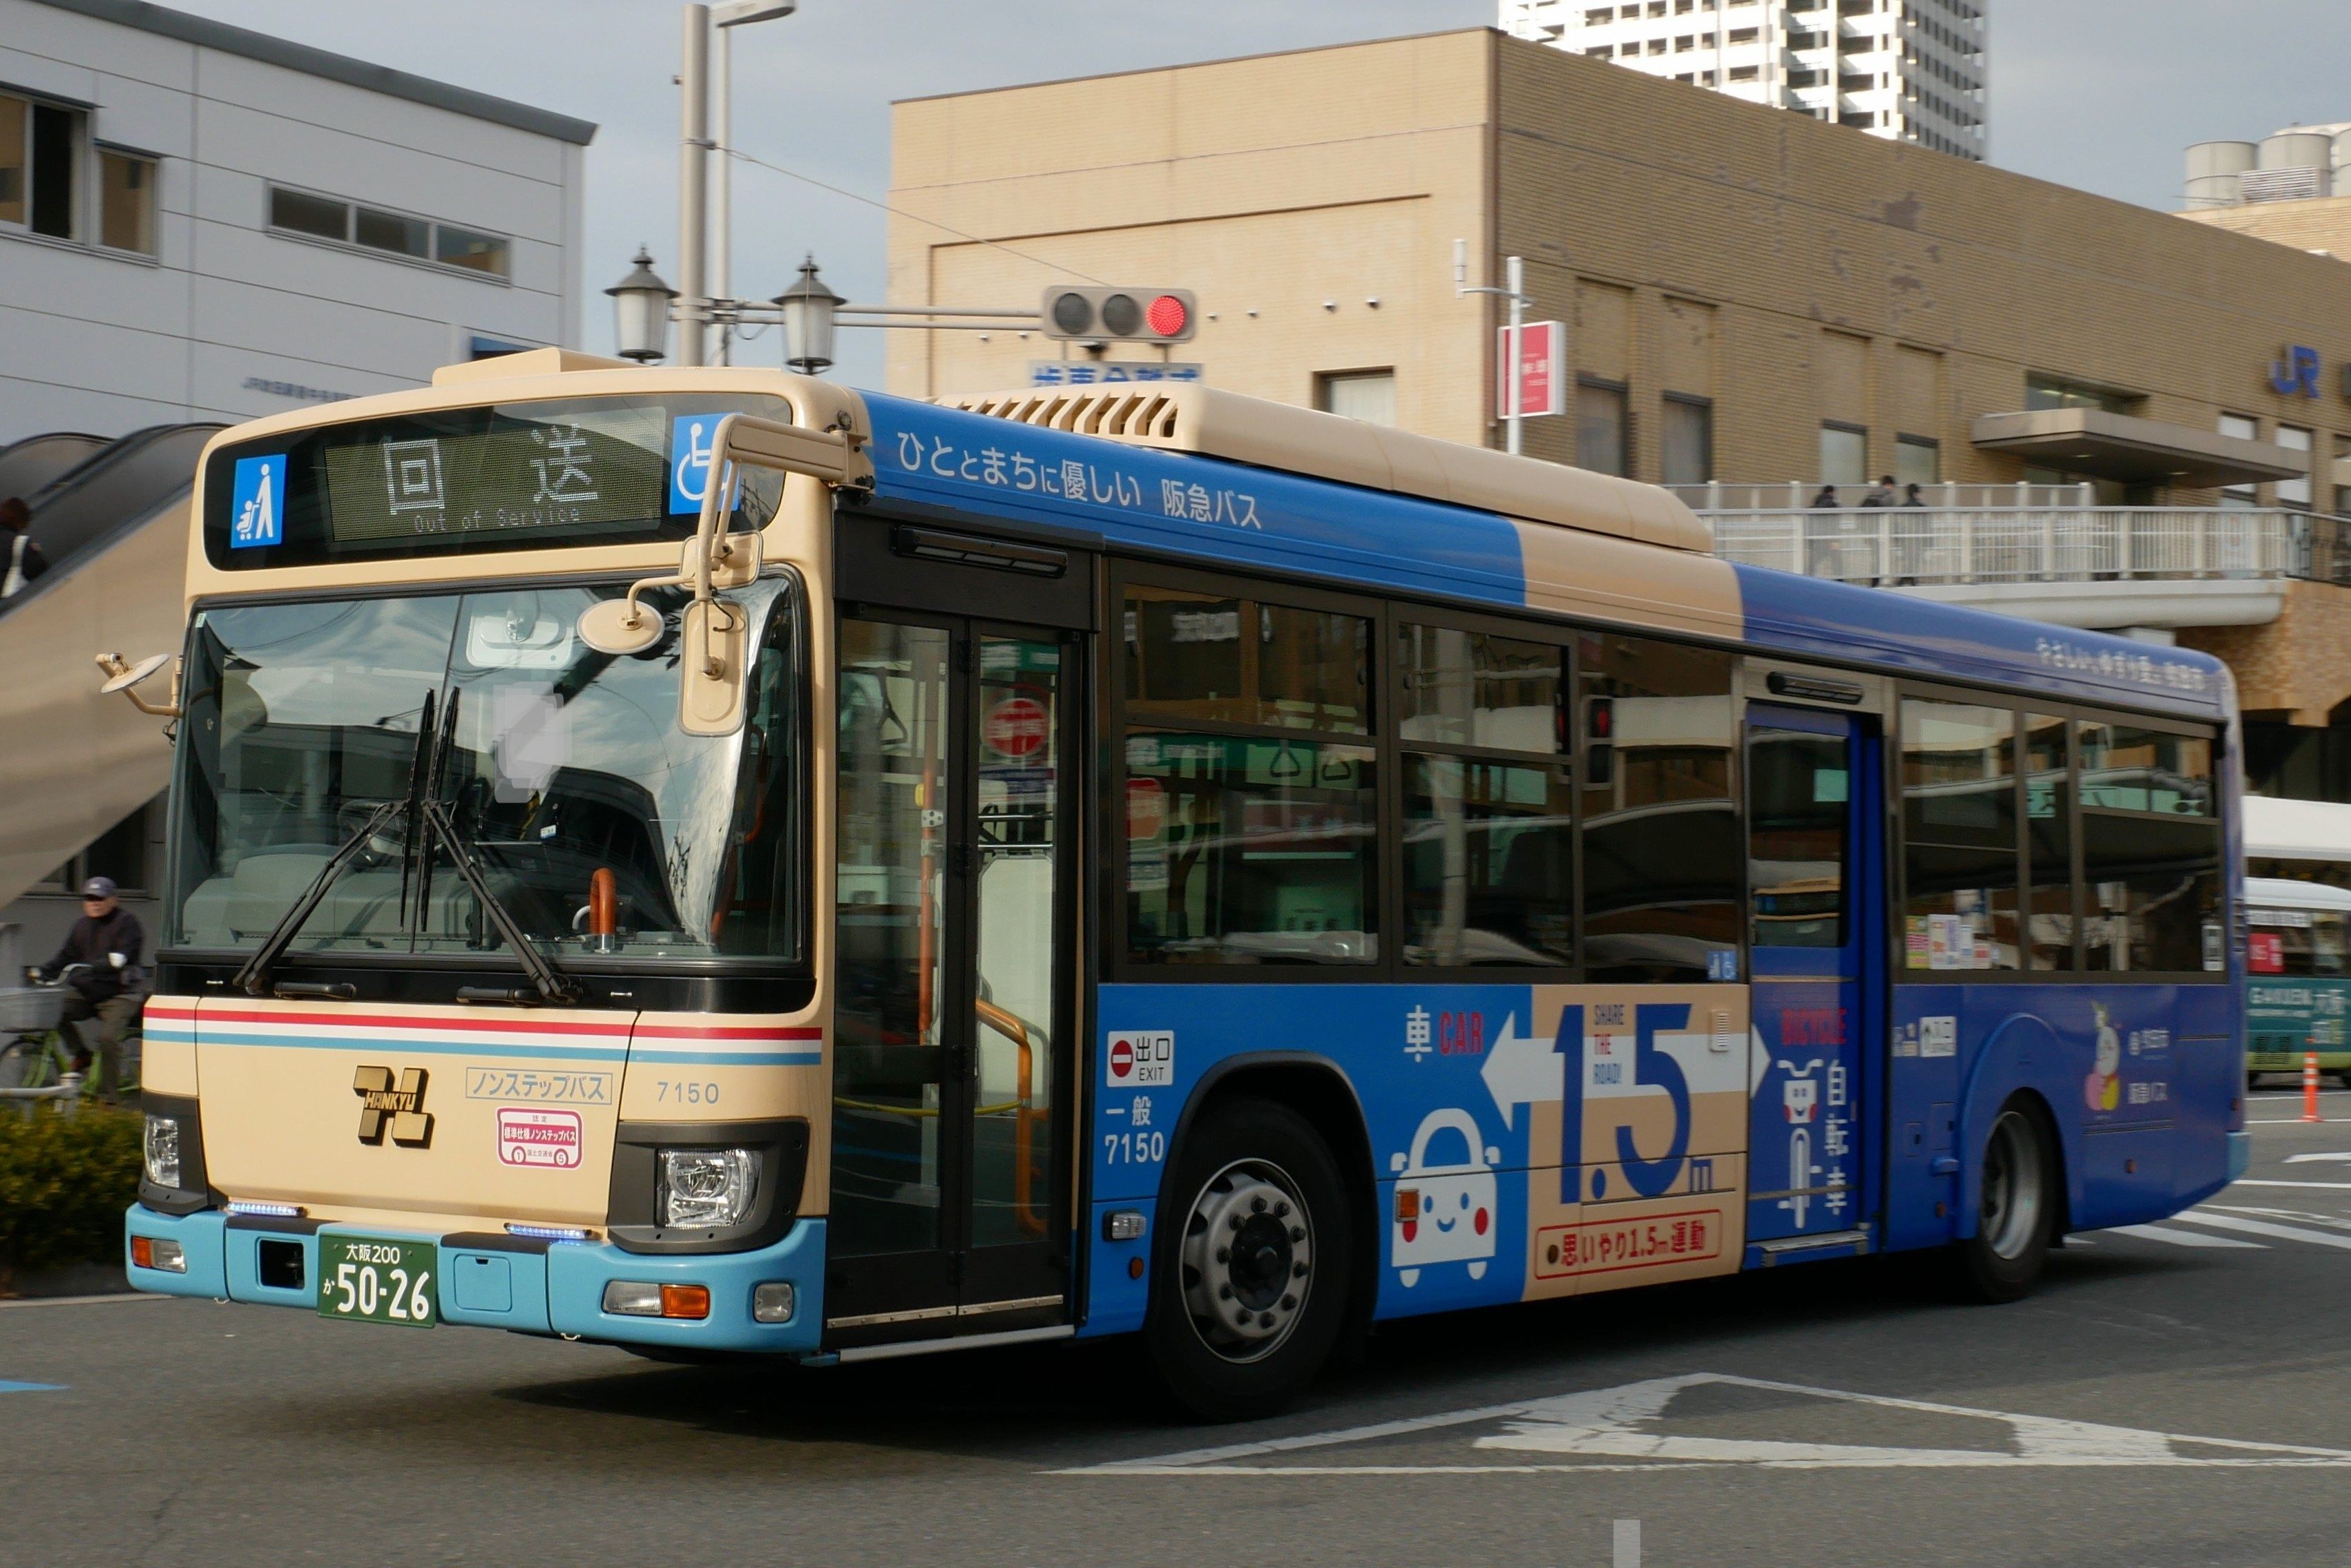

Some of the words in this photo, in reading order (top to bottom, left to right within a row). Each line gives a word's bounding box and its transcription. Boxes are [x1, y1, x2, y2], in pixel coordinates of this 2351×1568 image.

[2269, 345, 2319, 398] JR
[384, 423, 598, 515] 回送
[897, 432, 1141, 506] ひととまちに優しい
[1161, 478, 1262, 530] 阪急バス
[415, 512, 445, 532] Out
[462, 510, 482, 529] of
[497, 505, 579, 527] Service
[1594, 1004, 1624, 1026] SHARE
[1782, 1008, 1848, 1045] BICYCLE
[1403, 1004, 1433, 1063] 車
[1439, 1012, 1484, 1054] CAR
[1593, 1034, 1611, 1055] THE
[1135, 1036, 1170, 1062] 出口
[472, 1072, 605, 1101] ノンステップバス
[1139, 1067, 1164, 1081] EXIT
[365, 1091, 417, 1112] HANKYU
[658, 1081, 720, 1104] 7150
[1105, 1095, 1152, 1126] 一般
[1104, 1131, 1164, 1165] 7150
[346, 1243, 401, 1265] 大阪200
[1561, 1219, 1707, 1266] 思いやり1.5m運動
[323, 1278, 336, 1295] か
[337, 1263, 430, 1320] 50-26
